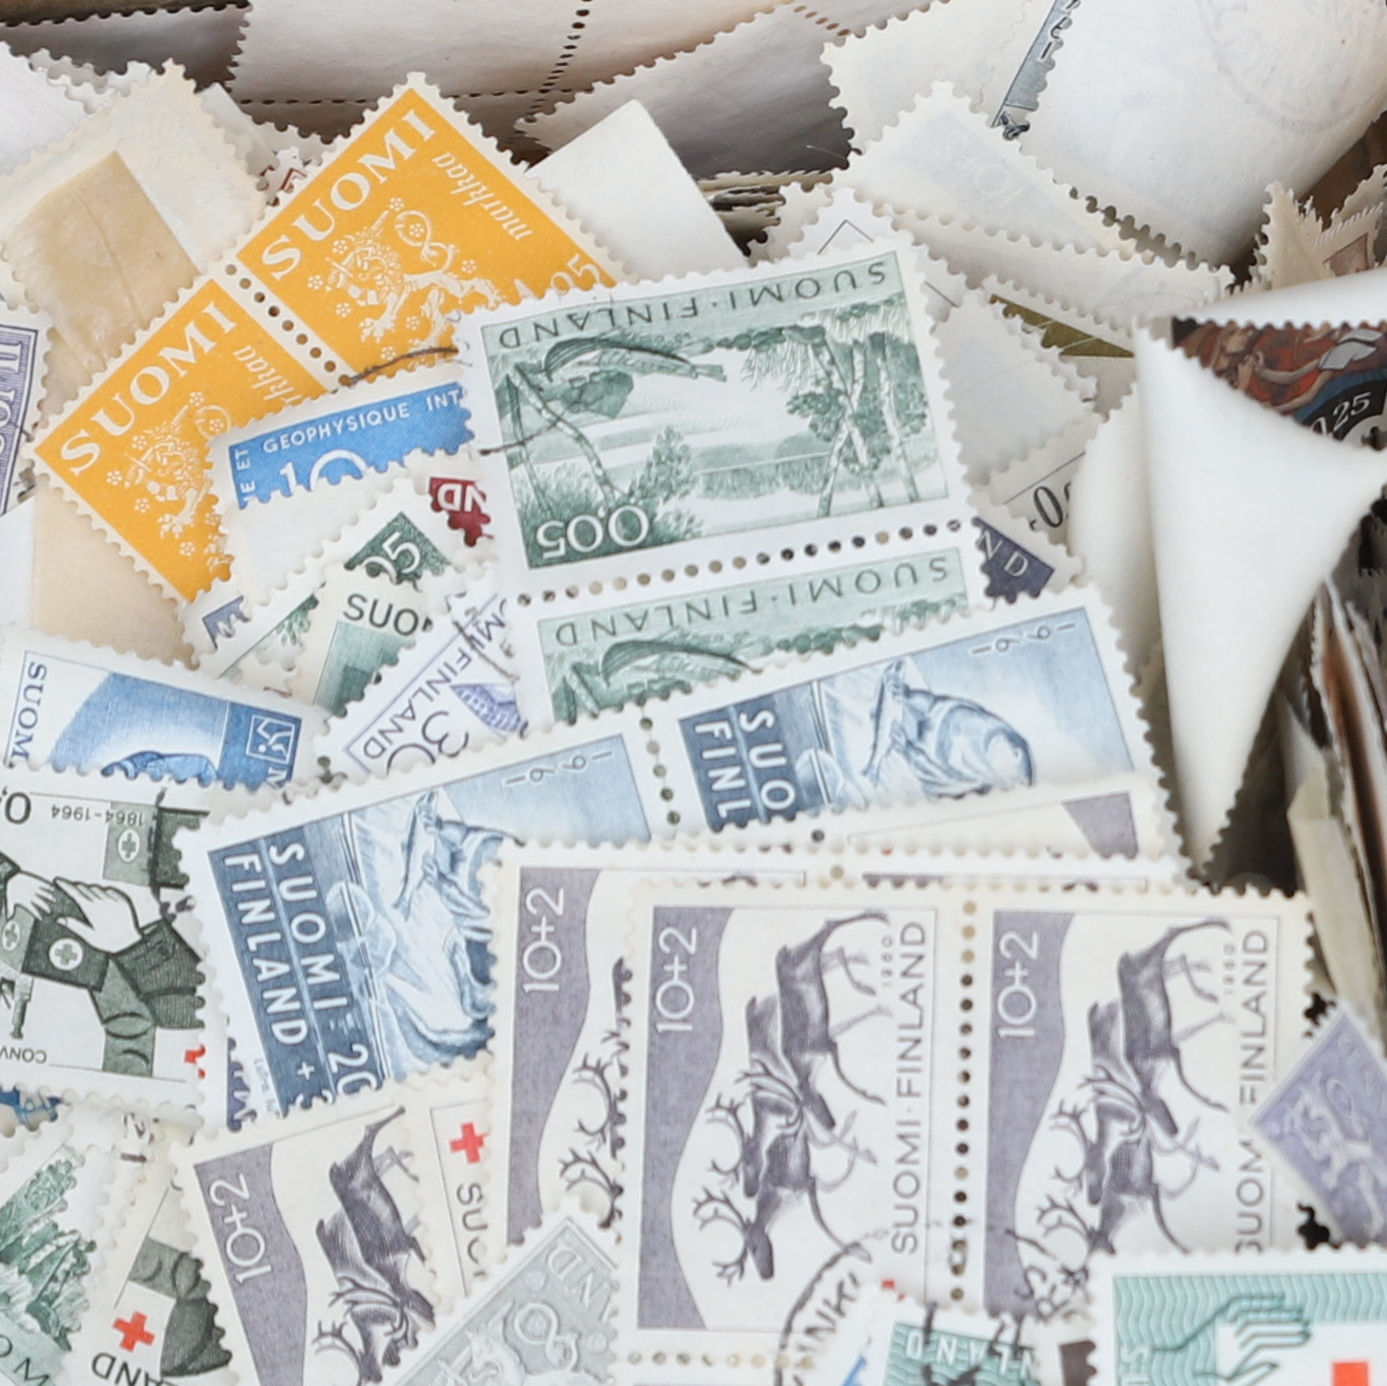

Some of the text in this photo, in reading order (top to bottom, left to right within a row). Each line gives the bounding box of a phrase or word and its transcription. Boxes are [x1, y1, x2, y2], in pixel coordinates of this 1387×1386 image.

[259, 107, 438, 282] SUOMI
[498, 259, 887, 351] SUOMI FINLAND
[58, 300, 239, 477] SUOMI
[262, 404, 412, 456] GEOPHYSIQUE
[556, 593, 757, 649] FINLAND
[788, 557, 950, 608] SUOMI
[224, 852, 309, 1047] FINLAND
[268, 841, 339, 1013] SUOMI
[521, 887, 566, 994] 10+2
[655, 925, 698, 1034] 10+2
[997, 930, 1041, 1039] 10+2
[892, 919, 925, 1256] SUOMI FINLAND
[1235, 928, 1270, 1255] SUOM FINLAND
[208, 1171, 273, 1287] 10+2
